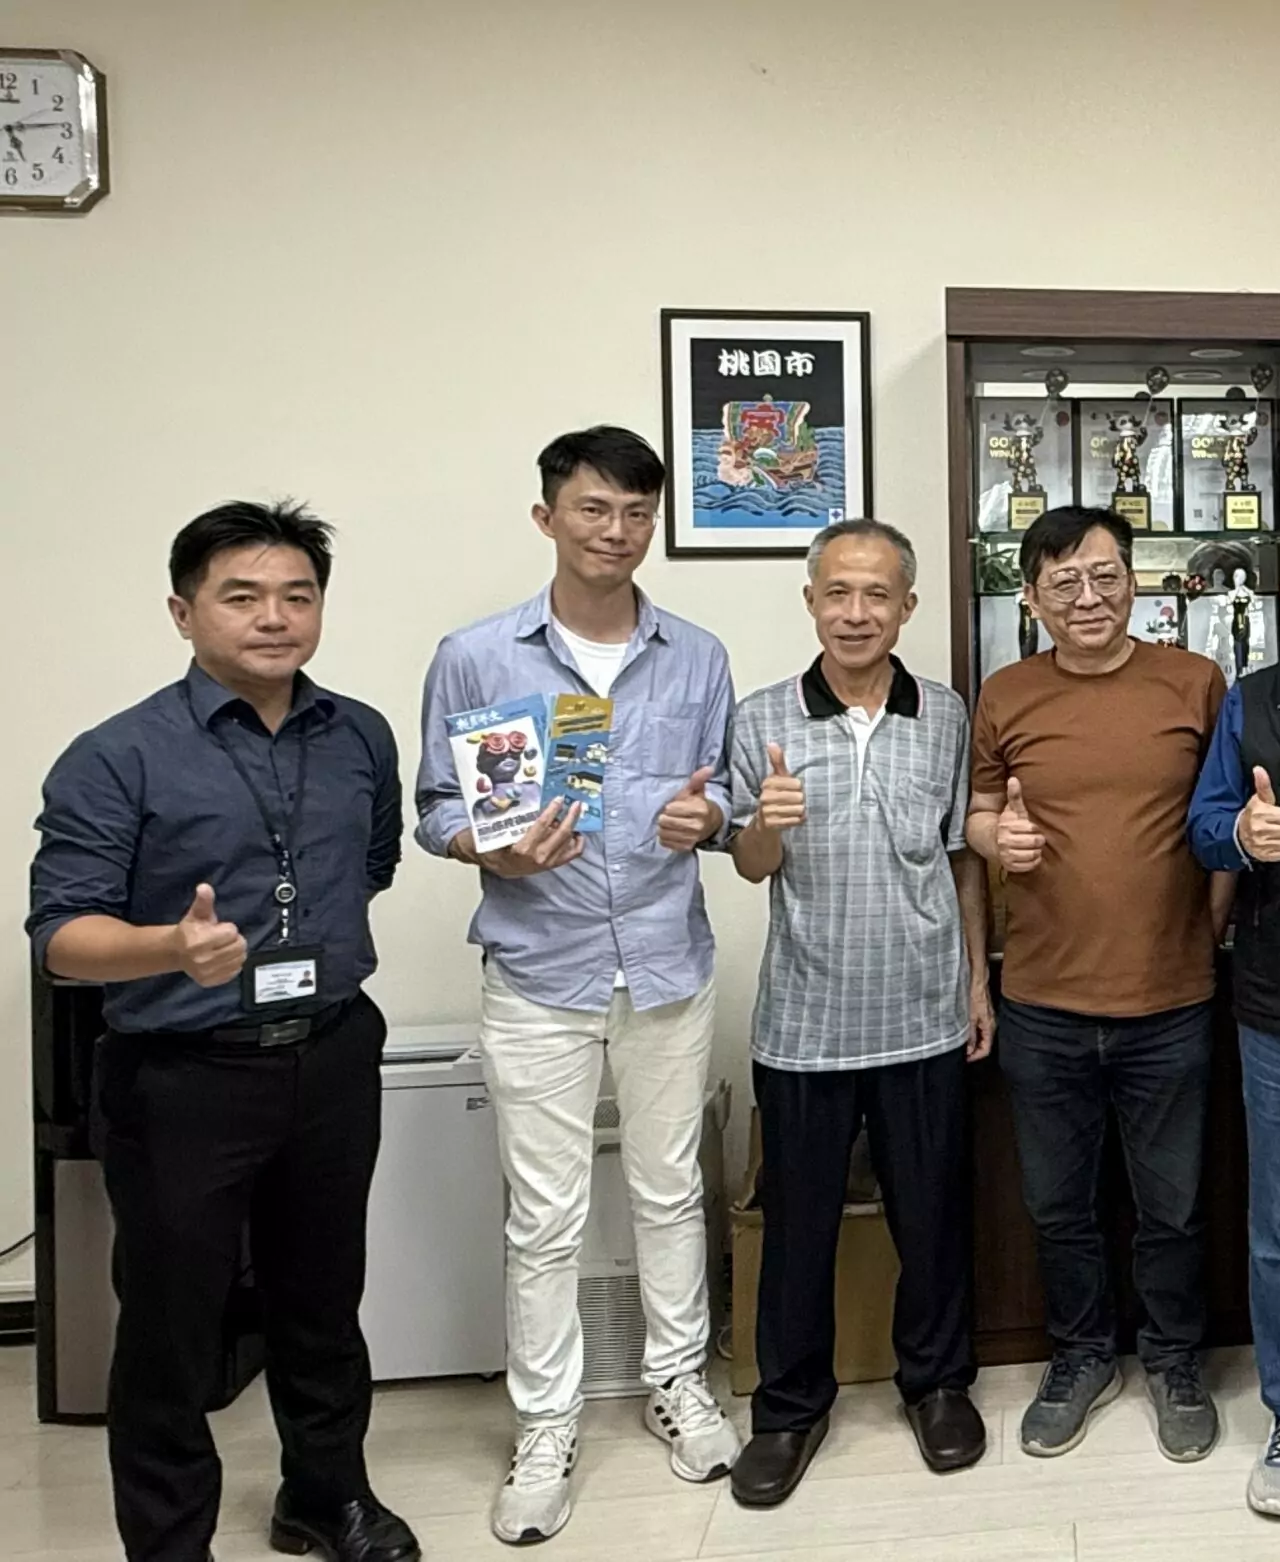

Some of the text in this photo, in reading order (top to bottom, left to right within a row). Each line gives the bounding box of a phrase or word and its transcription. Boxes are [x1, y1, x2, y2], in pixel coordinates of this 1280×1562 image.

[31, 79, 39, 95] 1
[52, 95, 64, 112] 2
[60, 122, 73, 140] 3
[52, 146, 64, 164] 4
[5, 167, 18, 185] 6
[31, 163, 44, 181] 5
[718, 349, 816, 377] 桃園市
